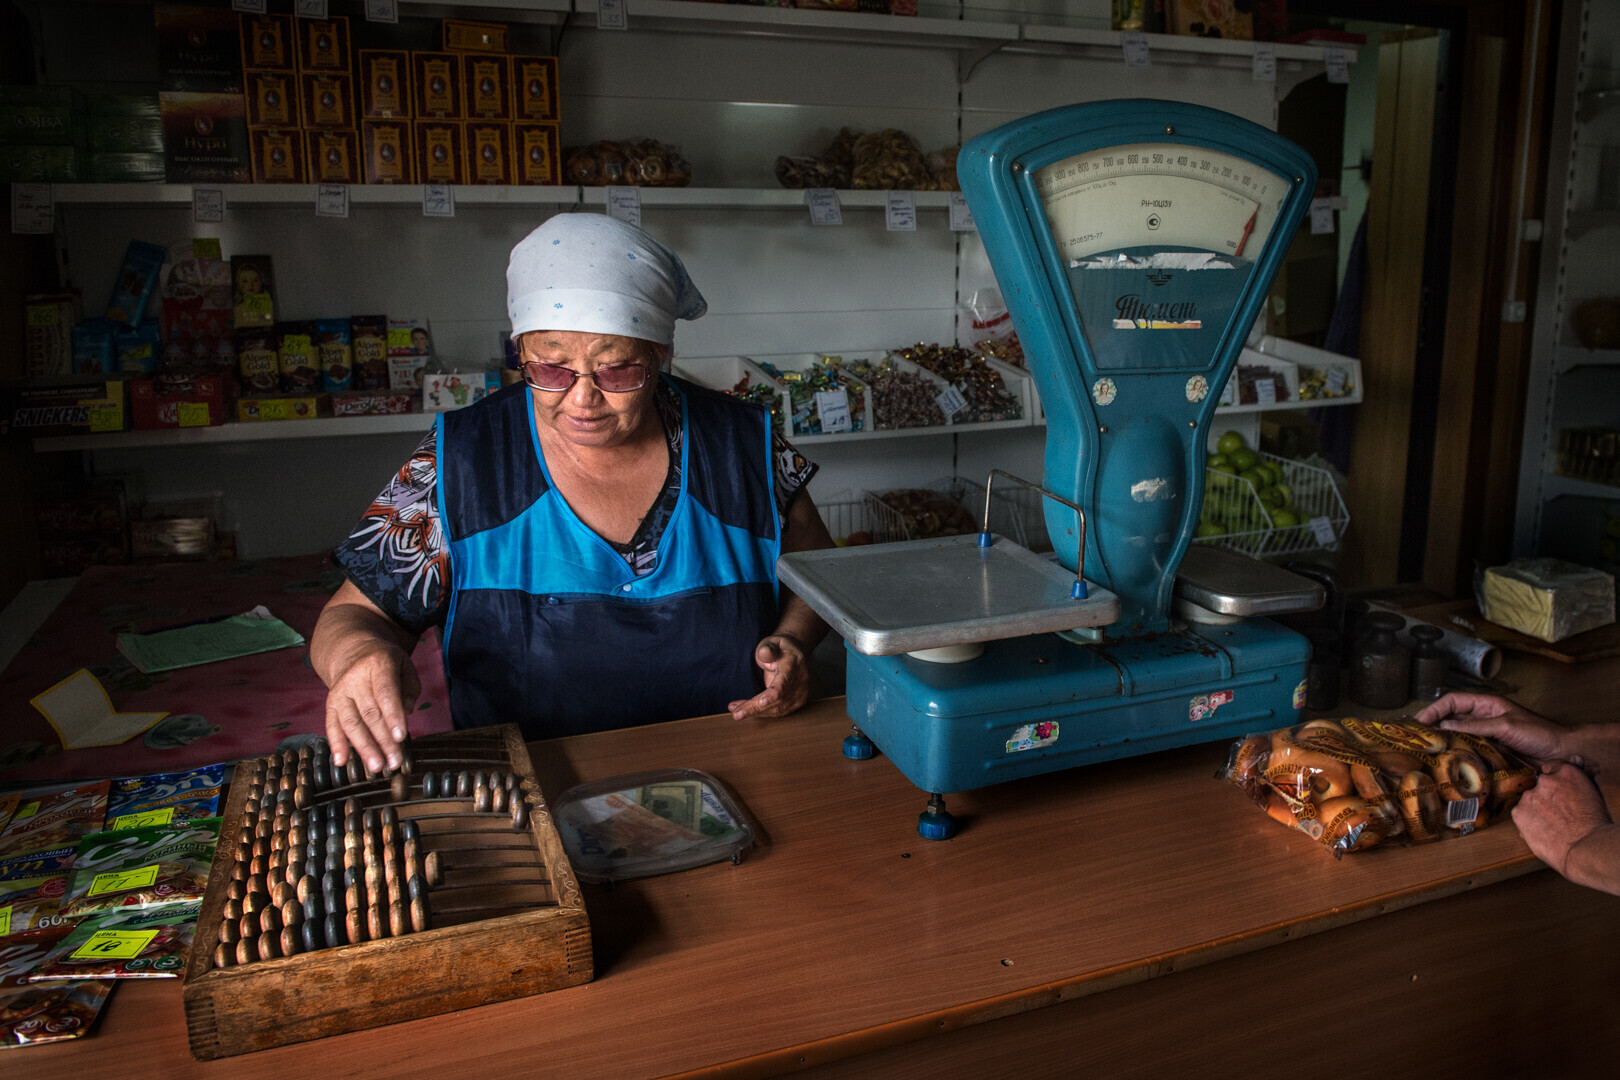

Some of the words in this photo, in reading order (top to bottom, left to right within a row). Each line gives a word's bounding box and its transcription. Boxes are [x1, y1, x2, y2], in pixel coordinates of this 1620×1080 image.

[1077, 162, 1089, 173] 800
[1103, 156, 1114, 167] 700
[1127, 154, 1139, 164] 600
[1152, 154, 1163, 163] 500
[1177, 156, 1188, 166] 400
[1200, 159, 1211, 171] 300
[1221, 166, 1232, 177] 200
[1261, 185, 1267, 194] 0
[358, 342, 382, 352] Alpen
[245, 353, 273, 363] Alpen
[358, 350, 380, 359] Gold
[247, 361, 271, 371] Gold
[285, 358, 308, 367] Gold
[344, 400, 370, 412] Dirol
[17, 407, 89, 426] SNICKERS
